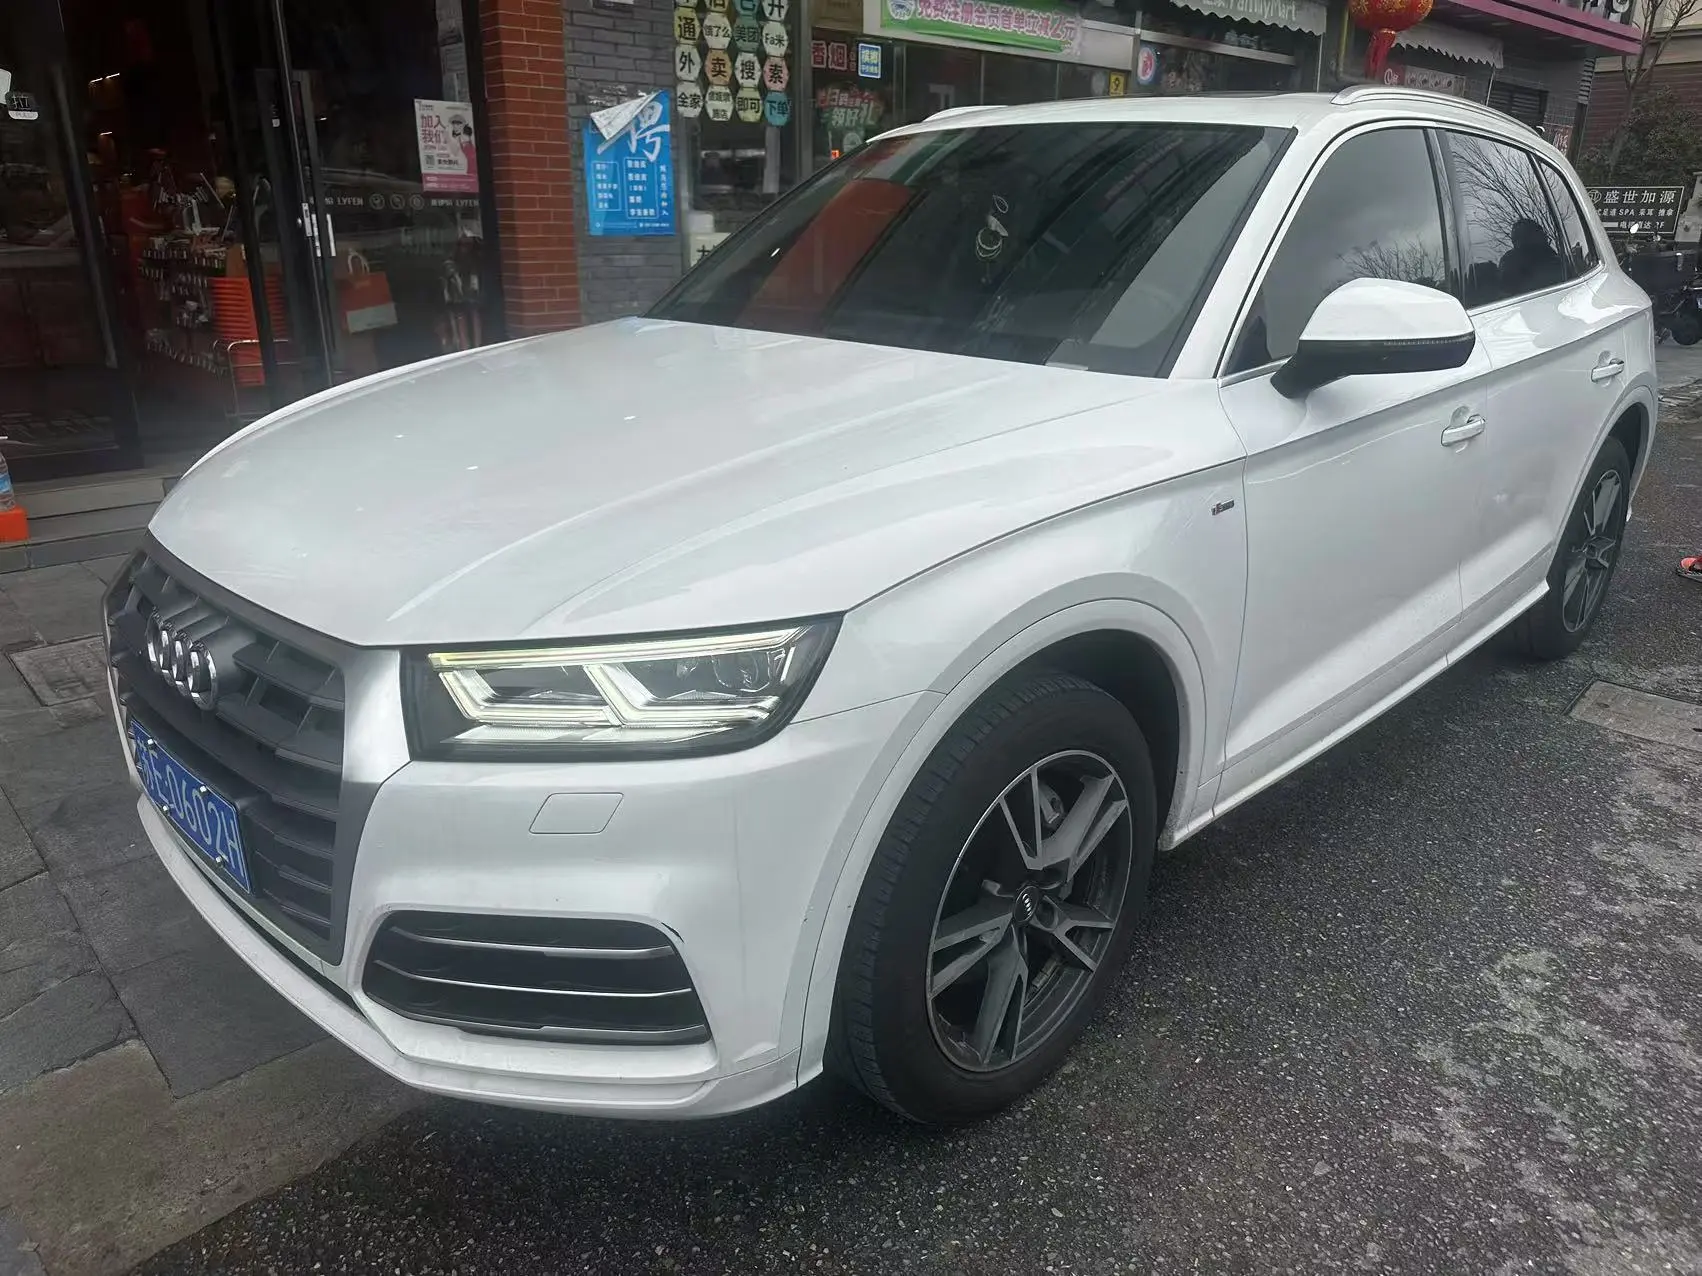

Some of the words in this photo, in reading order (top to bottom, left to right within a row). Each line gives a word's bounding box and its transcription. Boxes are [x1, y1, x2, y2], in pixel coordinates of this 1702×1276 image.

[677, 16, 697, 41] 通
[811, 41, 848, 71] 香烟
[679, 51, 695, 74] 外
[711, 57, 727, 78] 卖
[740, 60, 756, 80] 搜
[768, 64, 783, 84] 索
[678, 92, 701, 110] 全家
[737, 97, 760, 114] 即可
[767, 100, 790, 116] 下单
[421, 115, 446, 129] 加入
[1603, 190, 1677, 204] 盛世加源
[1618, 208, 1635, 216] SPA
